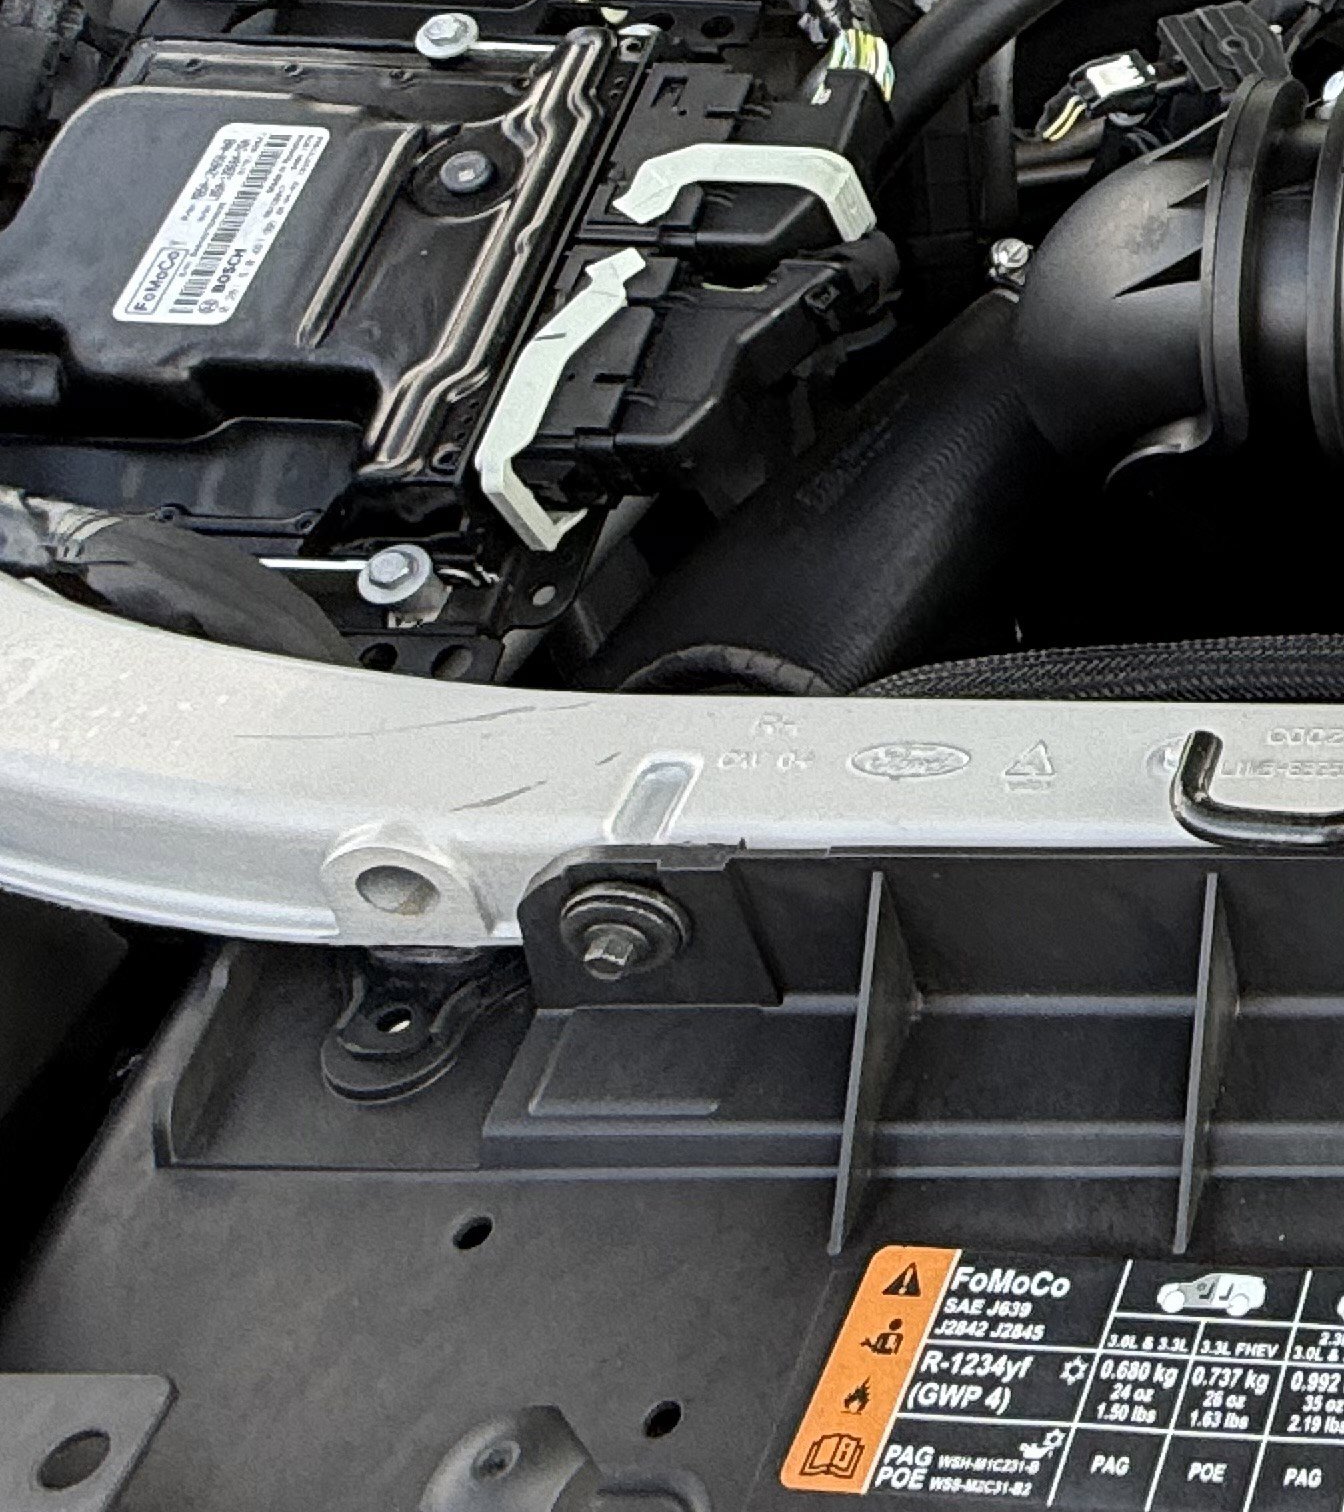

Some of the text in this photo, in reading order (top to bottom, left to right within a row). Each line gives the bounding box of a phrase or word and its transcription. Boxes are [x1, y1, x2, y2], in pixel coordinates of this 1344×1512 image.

[133, 250, 180, 312] FoMoCo
[211, 248, 248, 294] BOSCH
[950, 1266, 1071, 1298] FoMoCo
[943, 1297, 1033, 1318] SAE J639
[933, 1320, 1046, 1341] J2842 J2845
[1107, 1334, 1188, 1353] 3.0L & 3.3L
[1200, 1340, 1280, 1358] 3.3L FHEV
[1292, 1345, 1324, 1362] 3.0L
[1326, 1349, 1340, 1361] &
[920, 1350, 1035, 1384] R-1234yf
[1100, 1358, 1180, 1389] 0.680 kg
[1191, 1366, 1271, 1396] 0.737 kg
[1290, 1370, 1342, 1393] 0.992
[906, 1381, 1012, 1415] (GWP 4)
[1109, 1383, 1155, 1403] 24 oz
[1202, 1390, 1247, 1410] 26 oz
[1302, 1394, 1324, 1413] 35
[1096, 1402, 1157, 1424] 1.50 lbs
[1190, 1408, 1250, 1430] 1.63 lbs
[1287, 1414, 1322, 1434] 2.19
[883, 1444, 936, 1466] PAG
[1090, 1454, 1130, 1476] PAG
[874, 1466, 928, 1490] POE
[1187, 1461, 1228, 1483] POE
[1283, 1467, 1322, 1489] PAG
